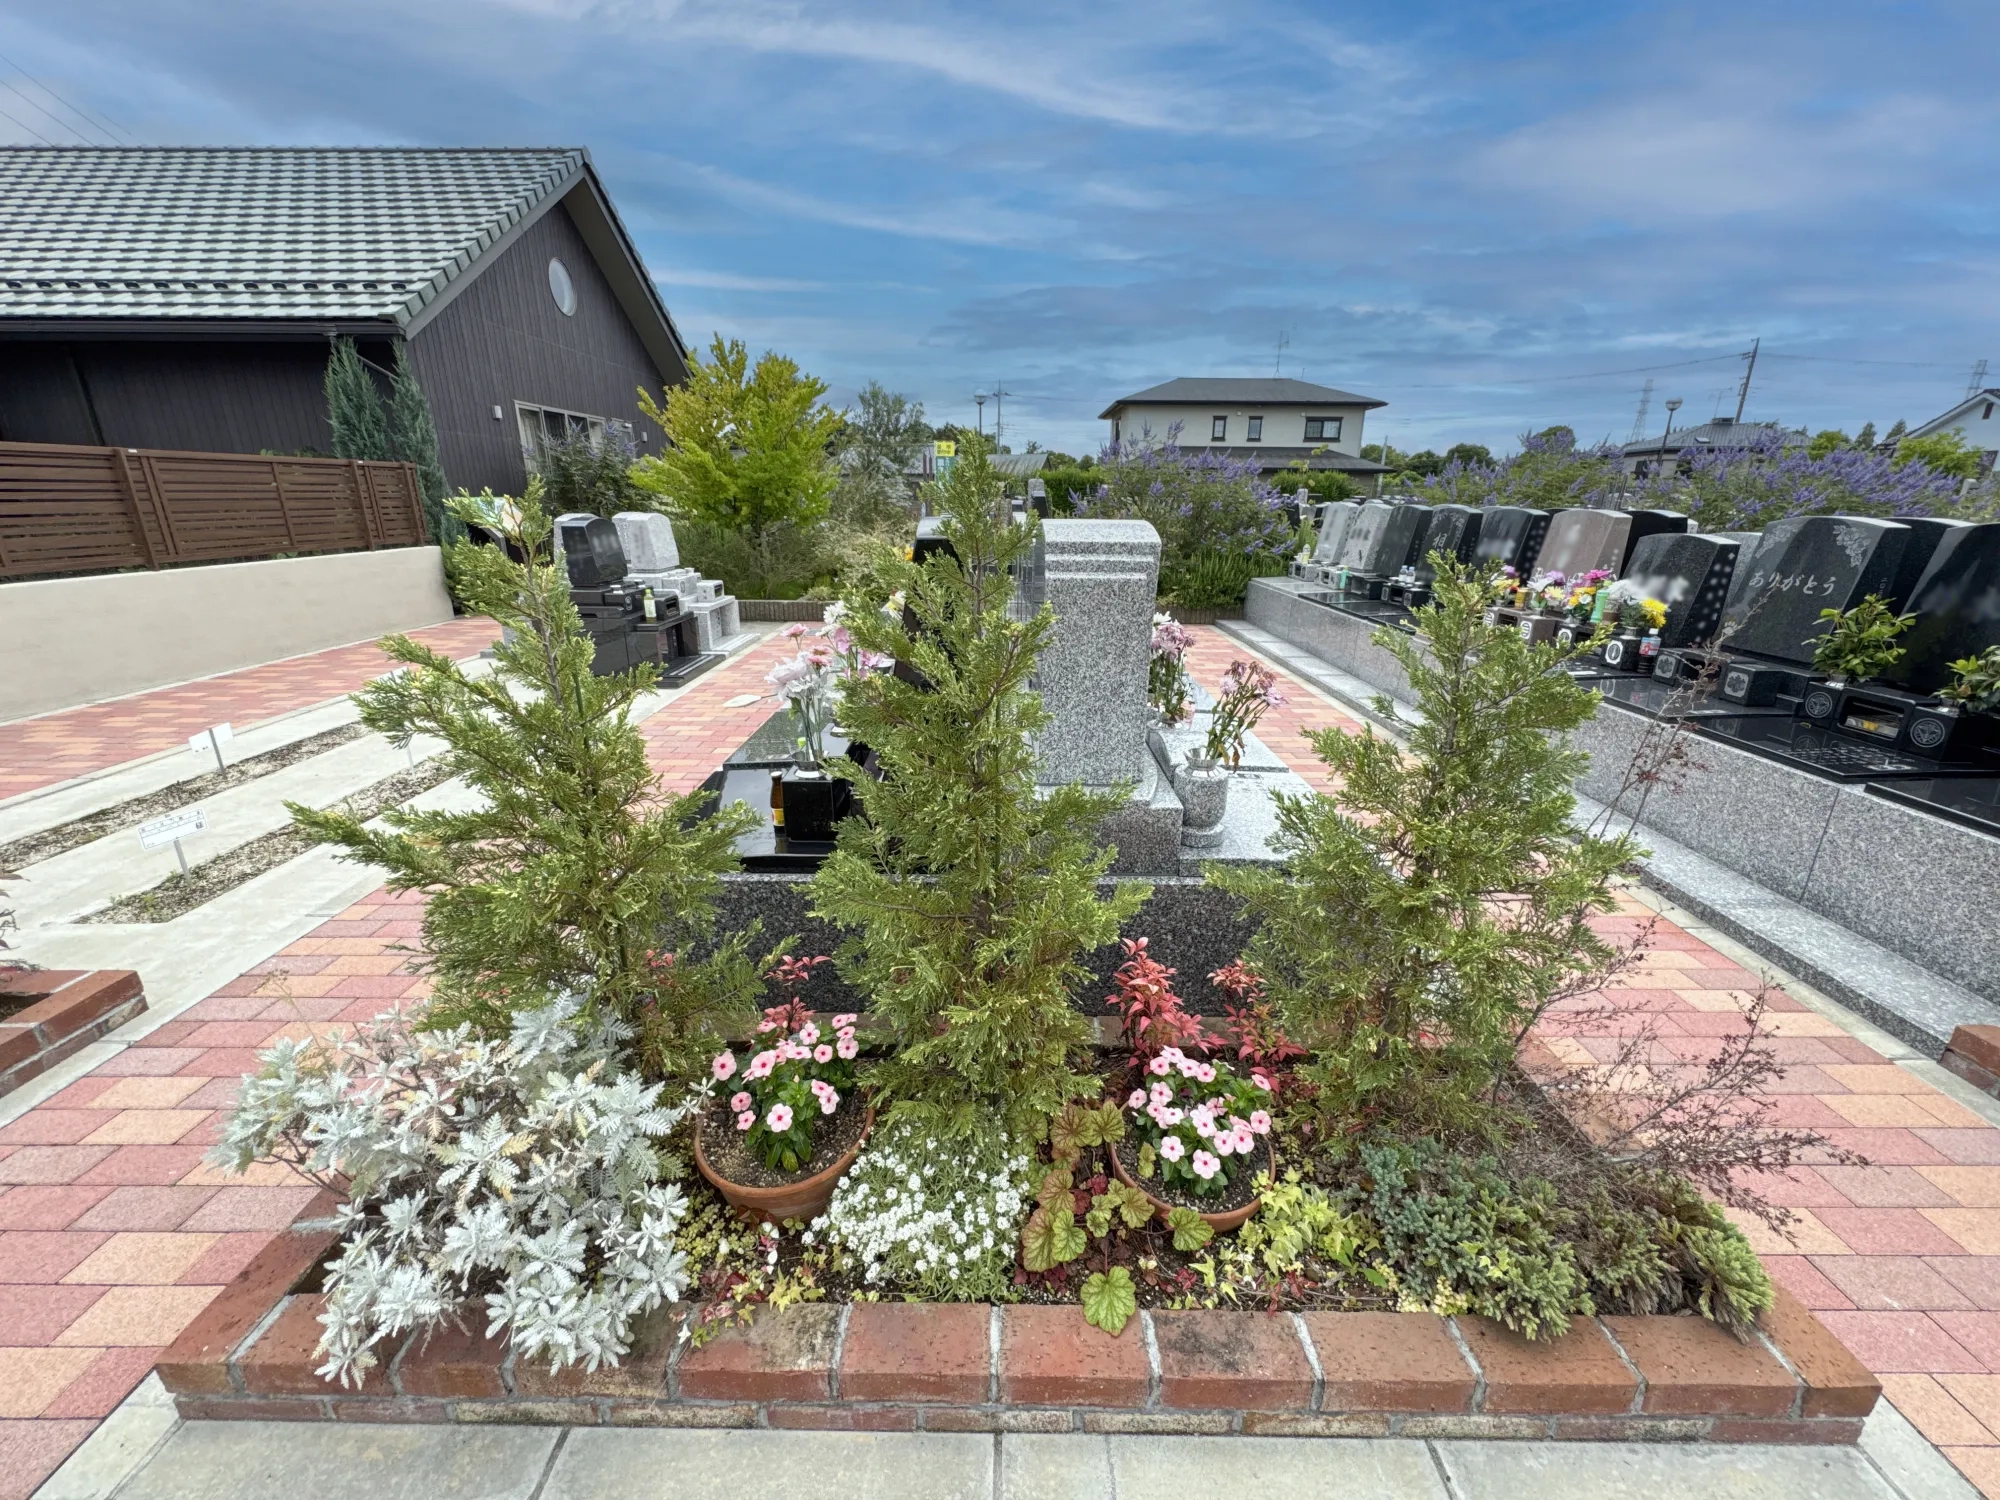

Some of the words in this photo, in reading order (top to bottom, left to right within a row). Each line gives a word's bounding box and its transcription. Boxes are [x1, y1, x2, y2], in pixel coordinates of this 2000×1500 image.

[1749, 569, 1837, 596] ありがとう
